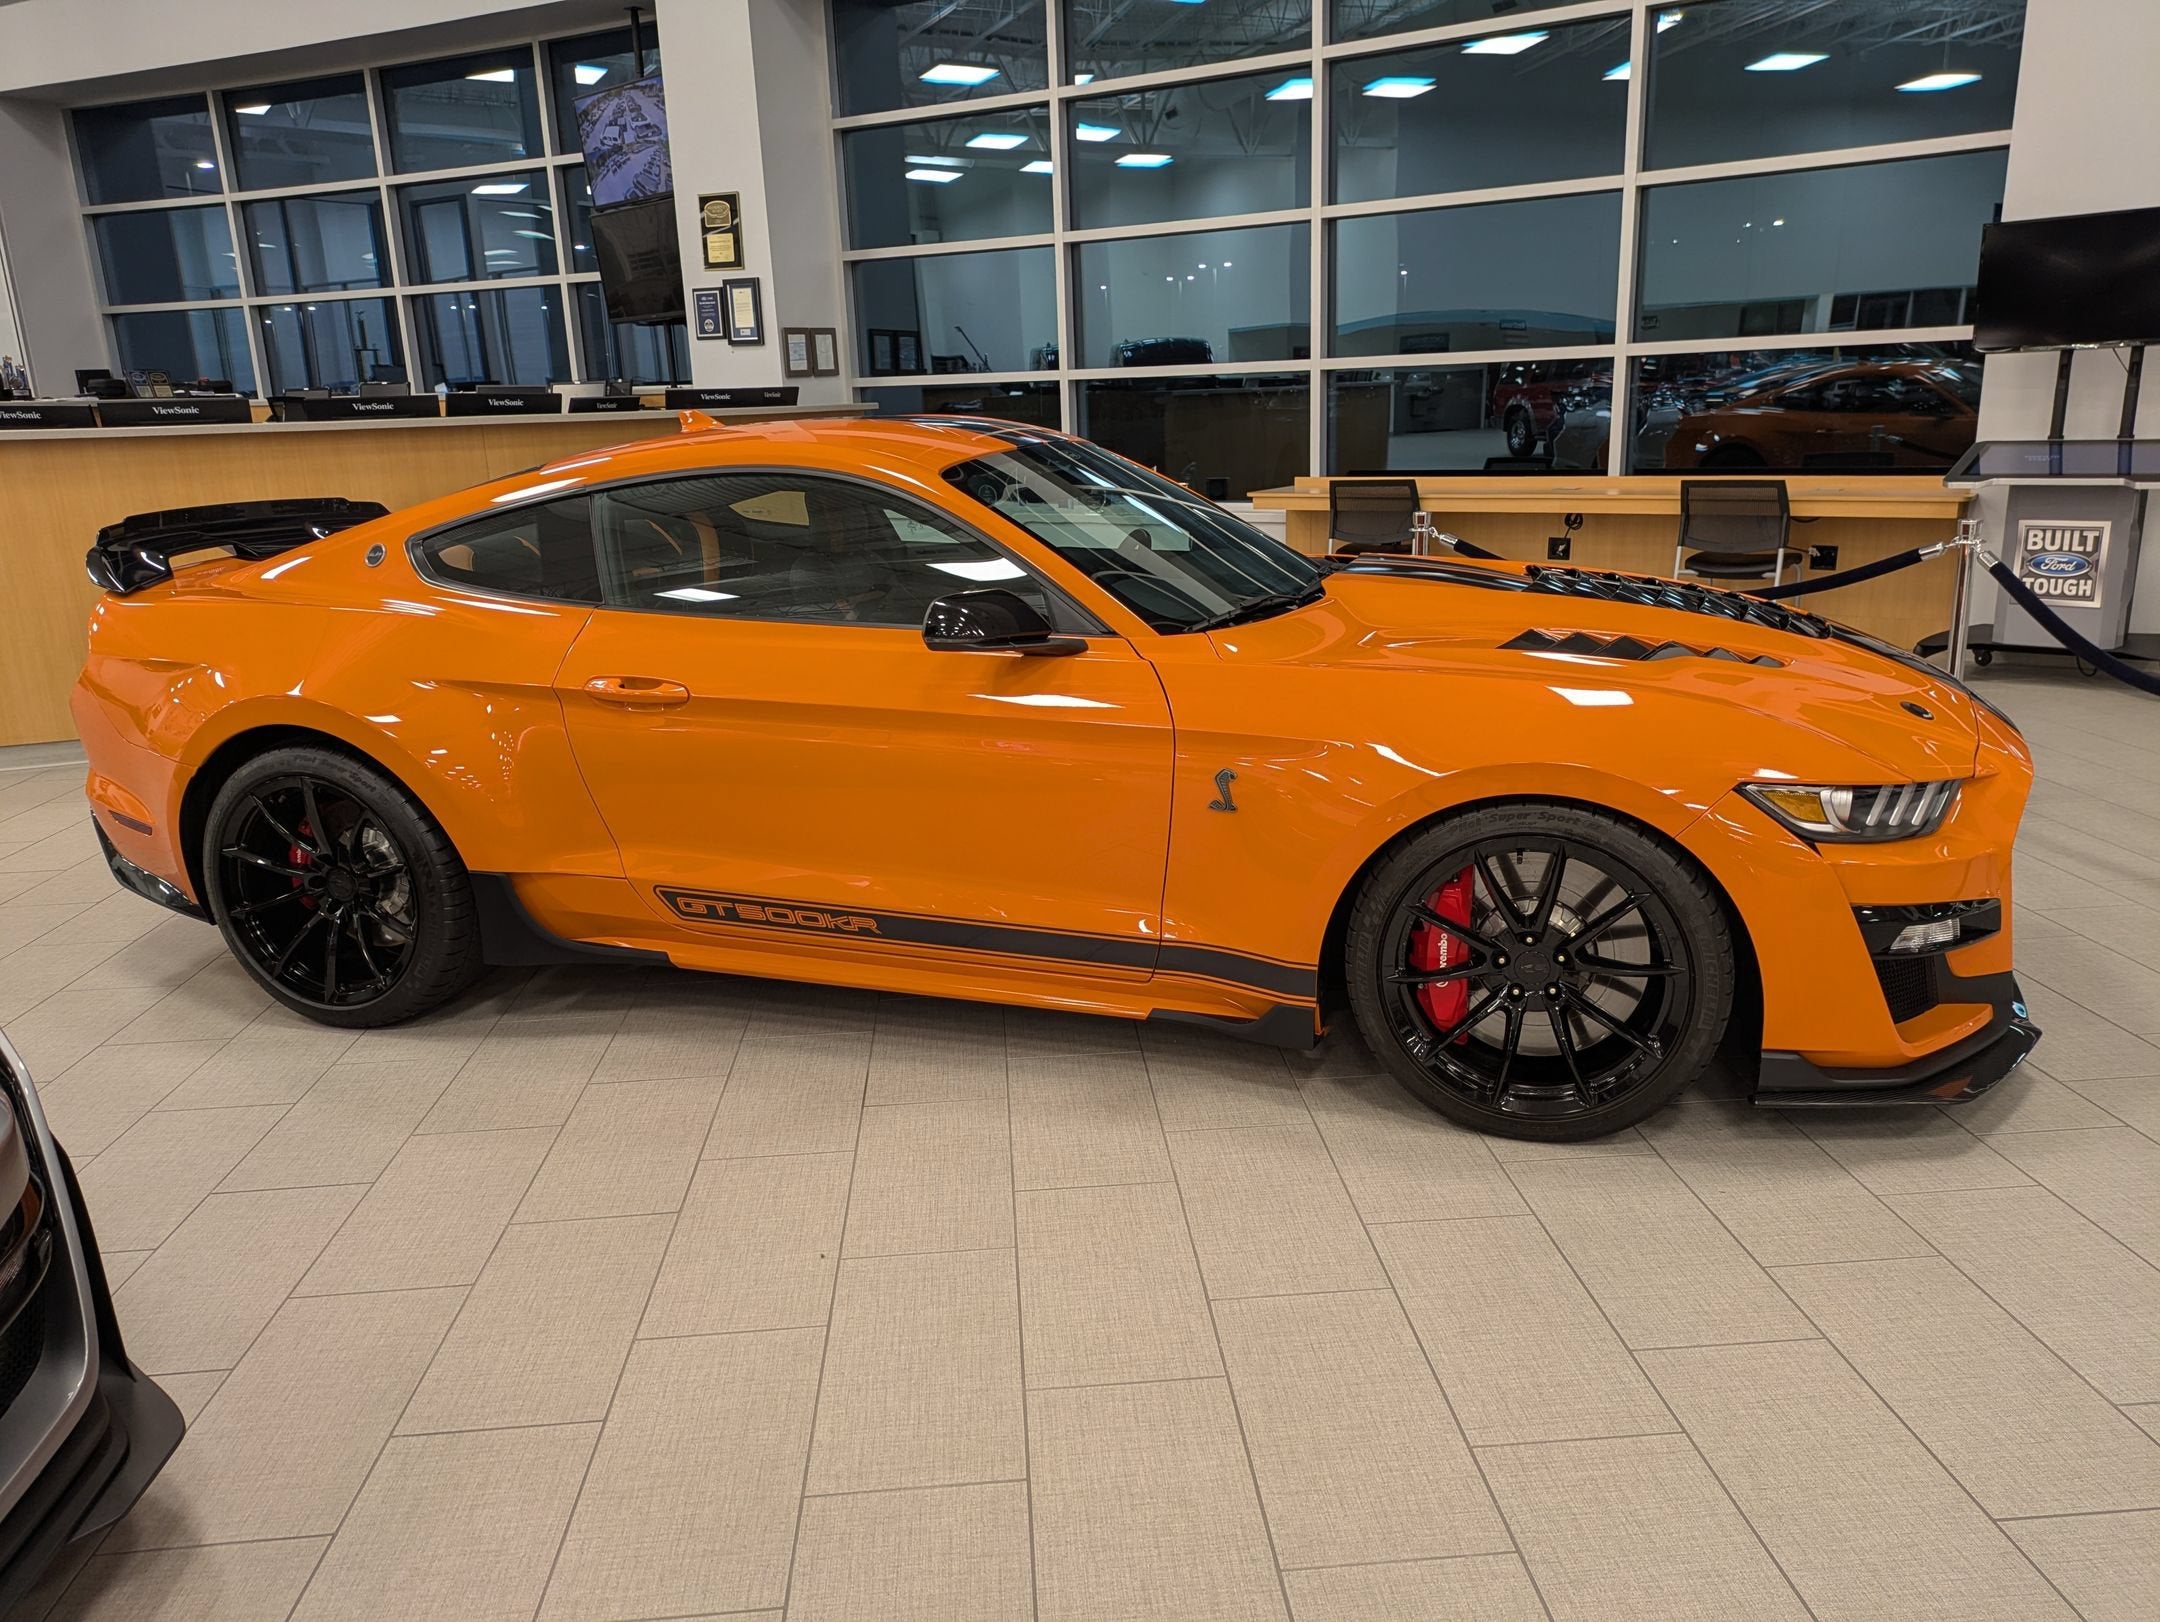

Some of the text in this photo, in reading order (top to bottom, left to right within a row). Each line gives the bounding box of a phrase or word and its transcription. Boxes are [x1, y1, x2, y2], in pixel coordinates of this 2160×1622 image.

[488, 398, 525, 407] ViewSonic
[699, 391, 732, 401] ViewSonic
[152, 406, 200, 416] ViewSonic
[352, 402, 395, 412] ViewSonic
[596, 402, 619, 410] ViewSonic
[2026, 529, 2100, 552] BUILT
[2040, 556, 2078, 572] Ford
[2022, 577, 2093, 597] TOUGH
[1488, 811, 1531, 823] Super
[1537, 811, 1582, 825] Sport
[677, 897, 882, 935] GT500KR
[1438, 932, 1448, 969] rembo
